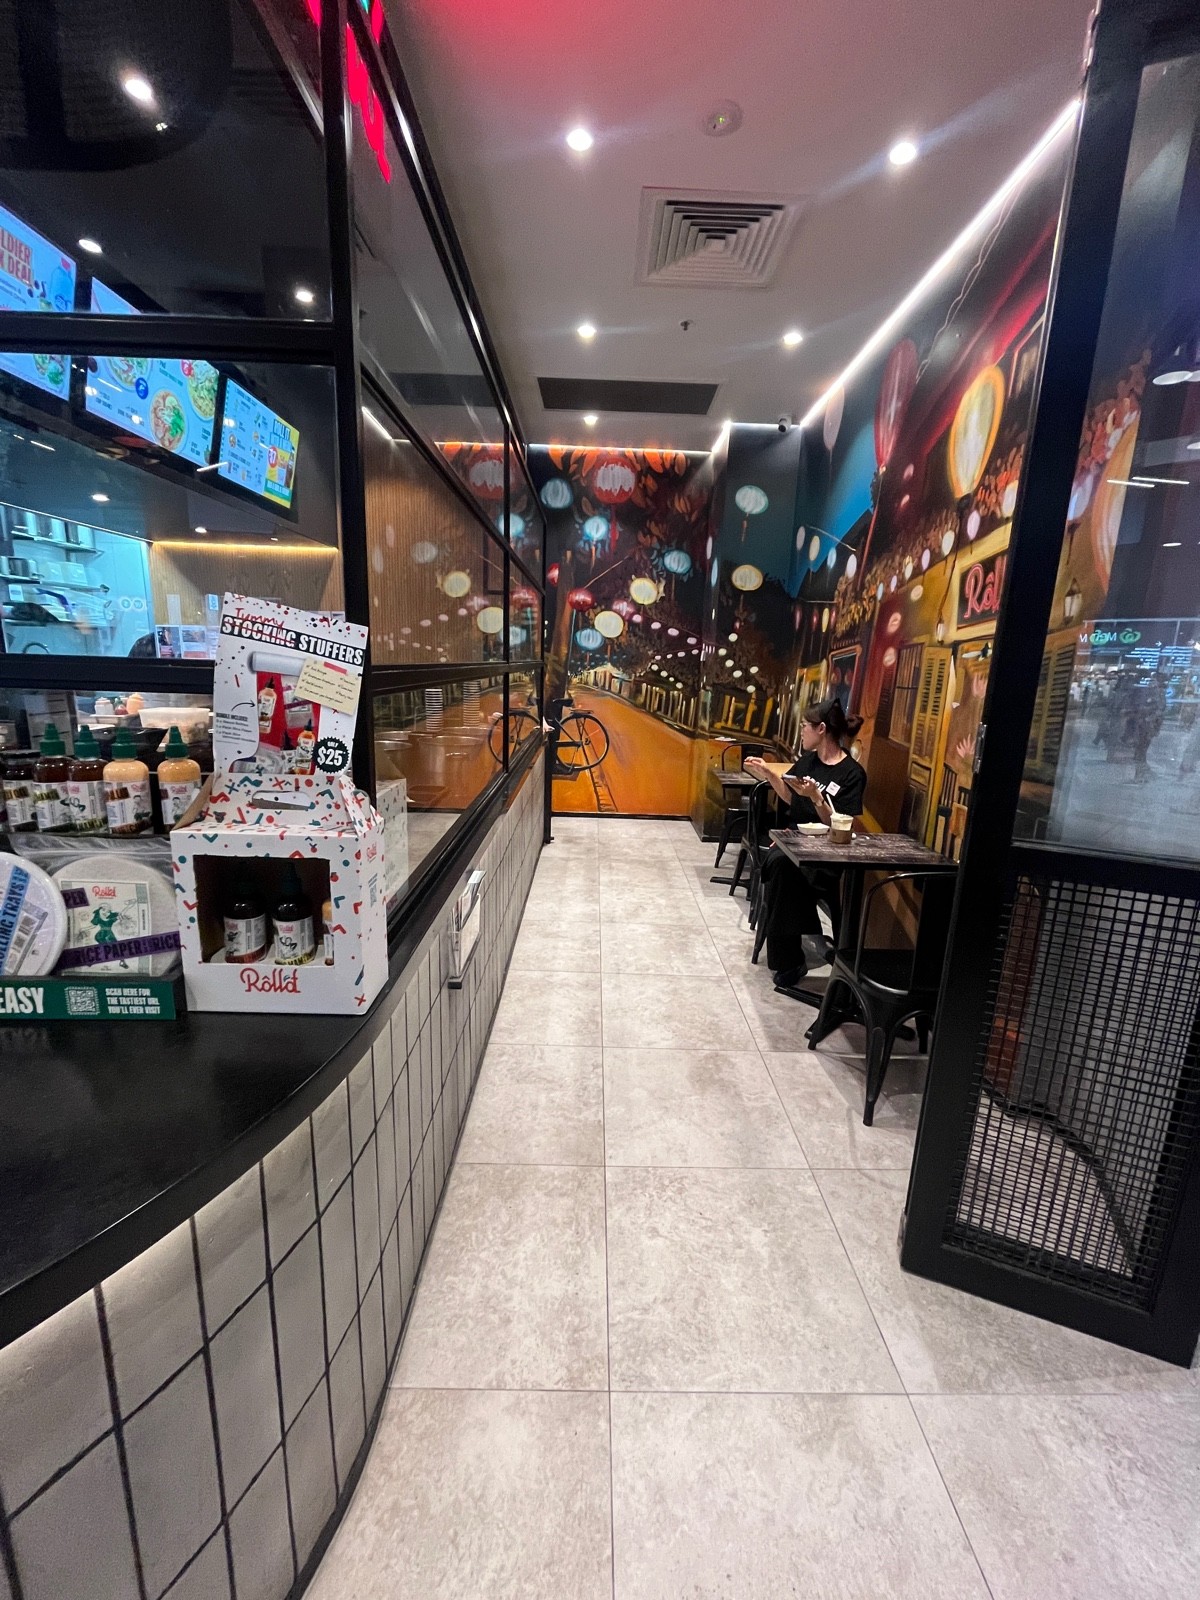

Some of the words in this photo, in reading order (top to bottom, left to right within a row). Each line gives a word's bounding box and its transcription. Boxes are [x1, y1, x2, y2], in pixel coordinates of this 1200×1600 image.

[222, 616, 297, 648] STOCKING
[298, 634, 364, 666] STUFFERS
[5, 881, 25, 916] TRAYS
[104, 939, 142, 959] PAPER
[105, 988, 122, 996] SCAN
[123, 988, 138, 996] HERE
[139, 988, 151, 997] FOR
[107, 997, 119, 1005] THE
[129, 1006, 144, 1014] EVER
